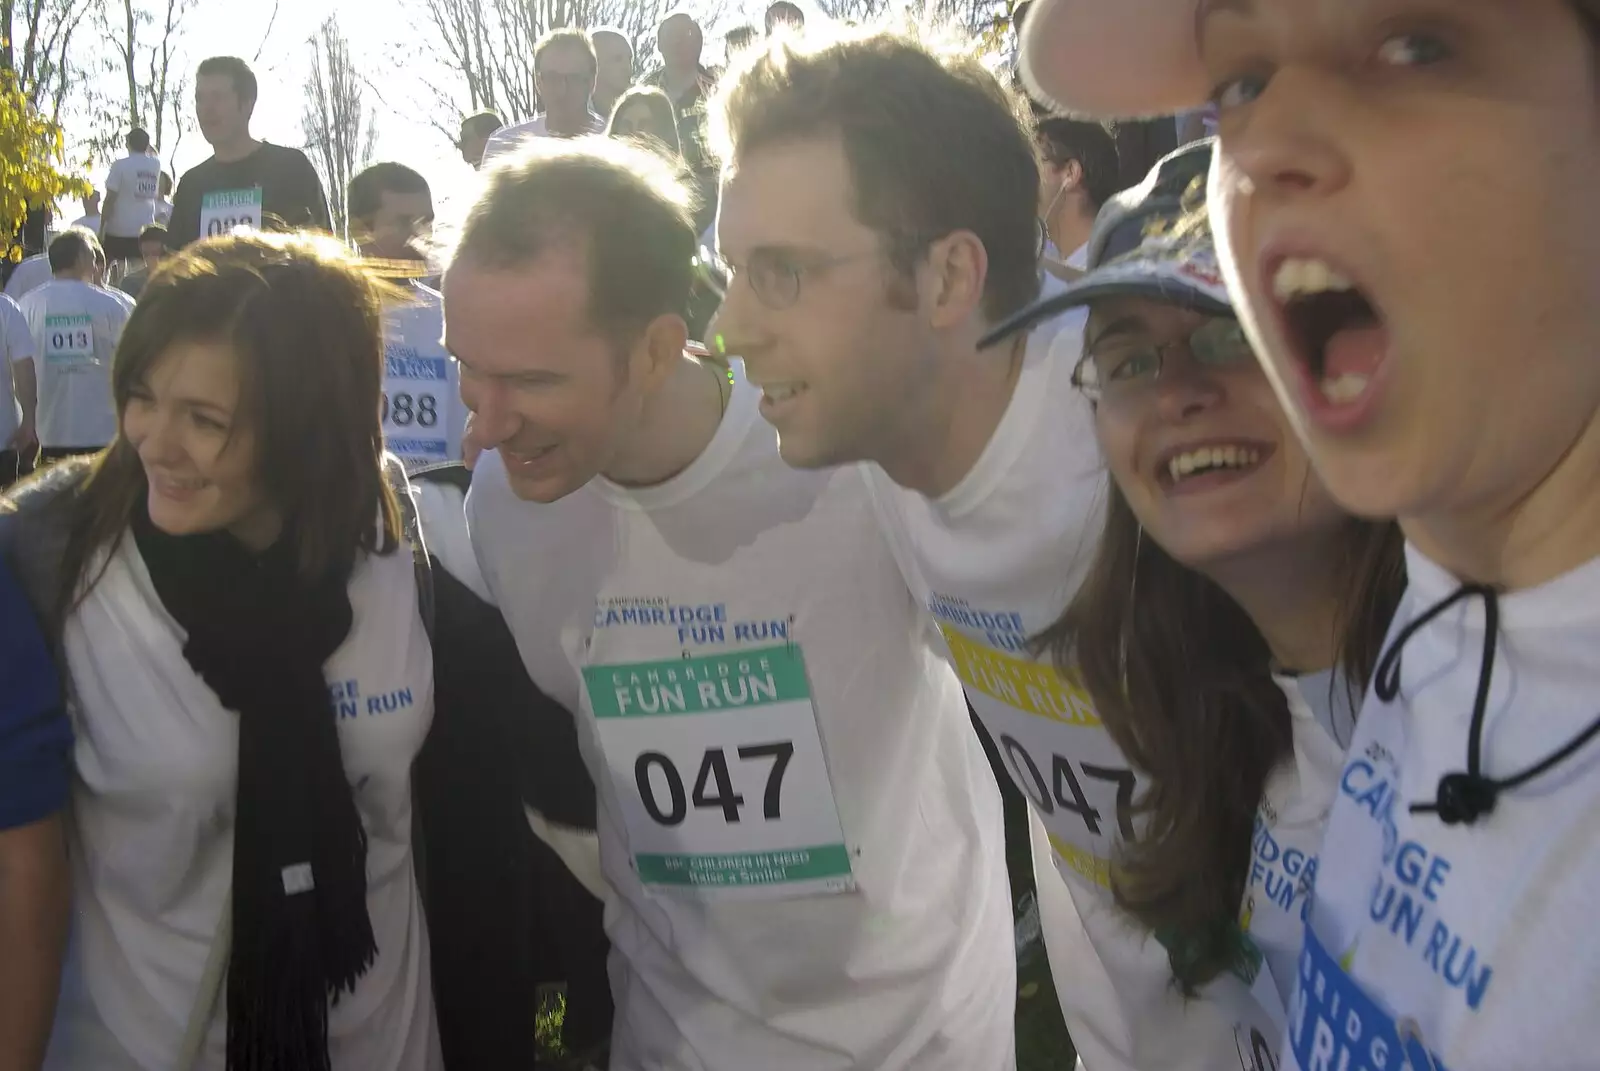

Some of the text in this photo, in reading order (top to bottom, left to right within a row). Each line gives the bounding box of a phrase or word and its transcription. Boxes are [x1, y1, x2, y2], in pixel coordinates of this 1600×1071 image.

[52, 332, 88, 350] 013
[594, 603, 727, 629] CAMBRIDGE
[677, 619, 787, 645] FUN RUN
[612, 655, 770, 686] CAMBRIDGE
[367, 687, 413, 716] RUN
[615, 672, 777, 716] FUN RUN
[634, 740, 795, 827] 047
[1000, 733, 1137, 844] 047
[1250, 860, 1295, 914] FUN
[1368, 872, 1494, 1011] UN RUN
